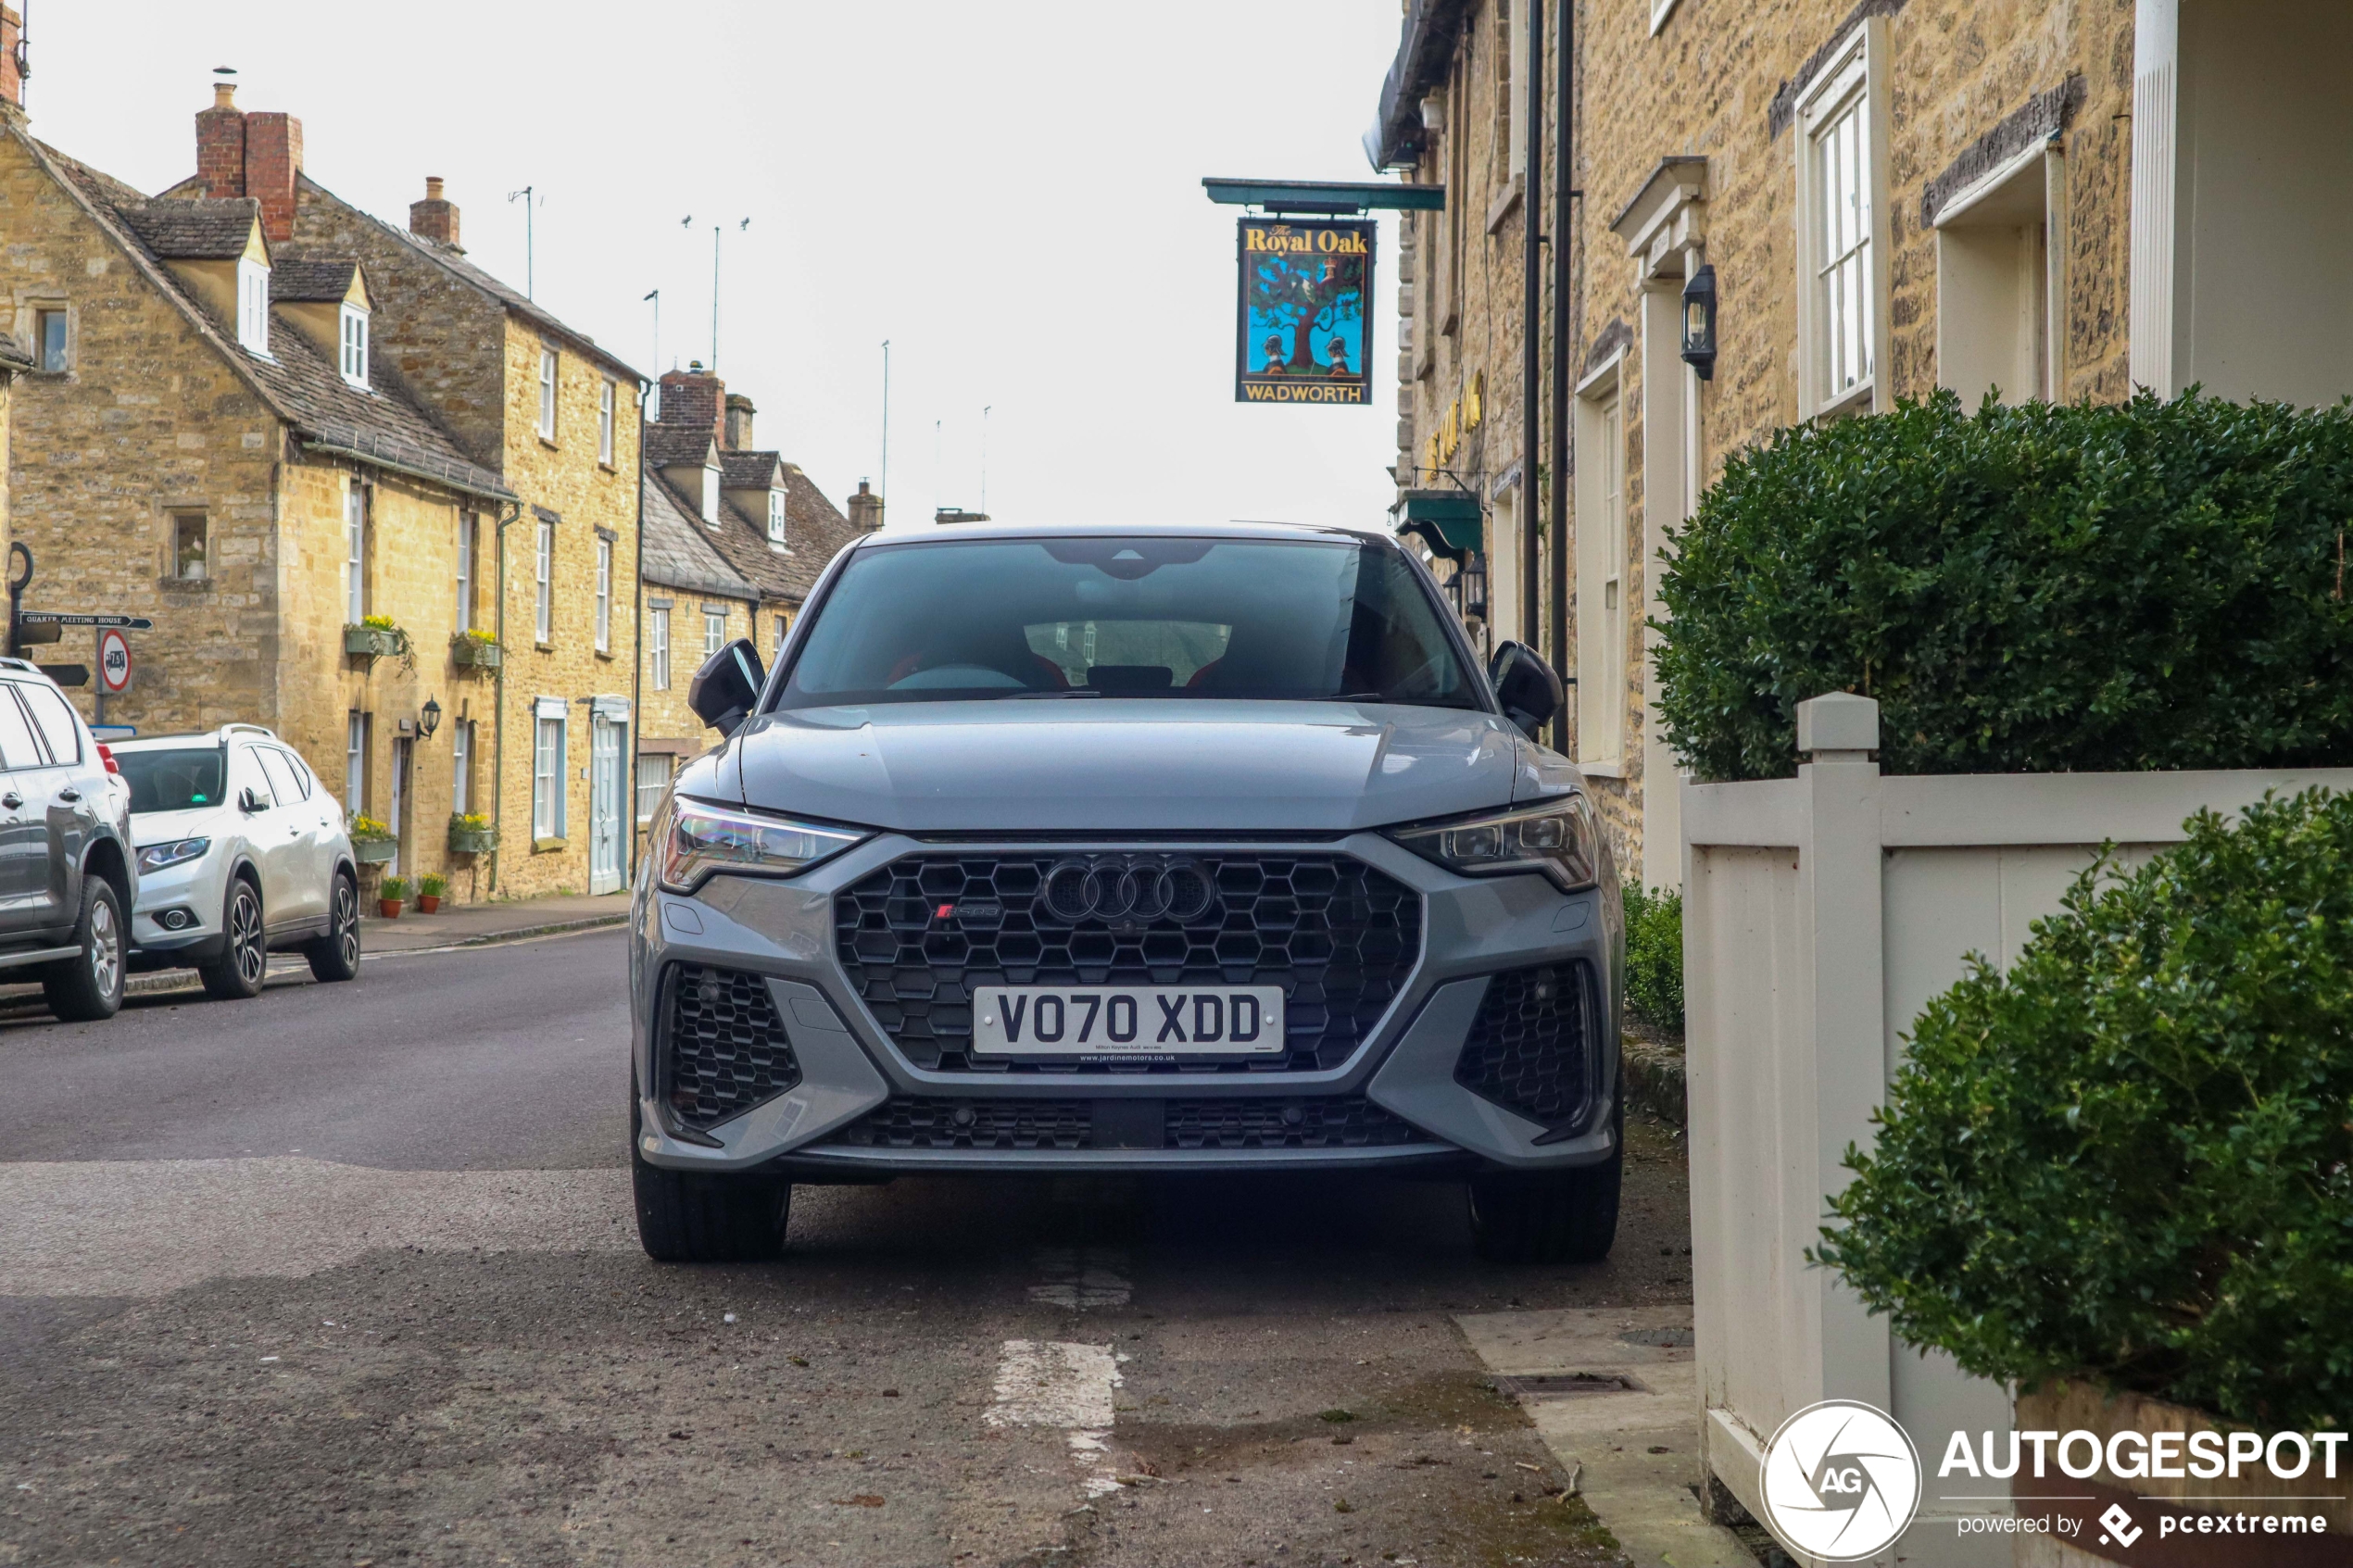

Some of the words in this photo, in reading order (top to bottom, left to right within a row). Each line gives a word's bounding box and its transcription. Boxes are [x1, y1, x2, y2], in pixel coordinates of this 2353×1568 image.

[1269, 224, 1291, 236] The
[1245, 228, 1313, 257] Royal
[1317, 230, 1368, 254] Oak
[1245, 384, 1362, 402] WADWORTH
[60, 616, 94, 624] MEETING
[998, 995, 1138, 1043] VO70
[1156, 995, 1260, 1043] XDD
[1079, 1054, 1176, 1063] www.jardinemotors.co.uk
